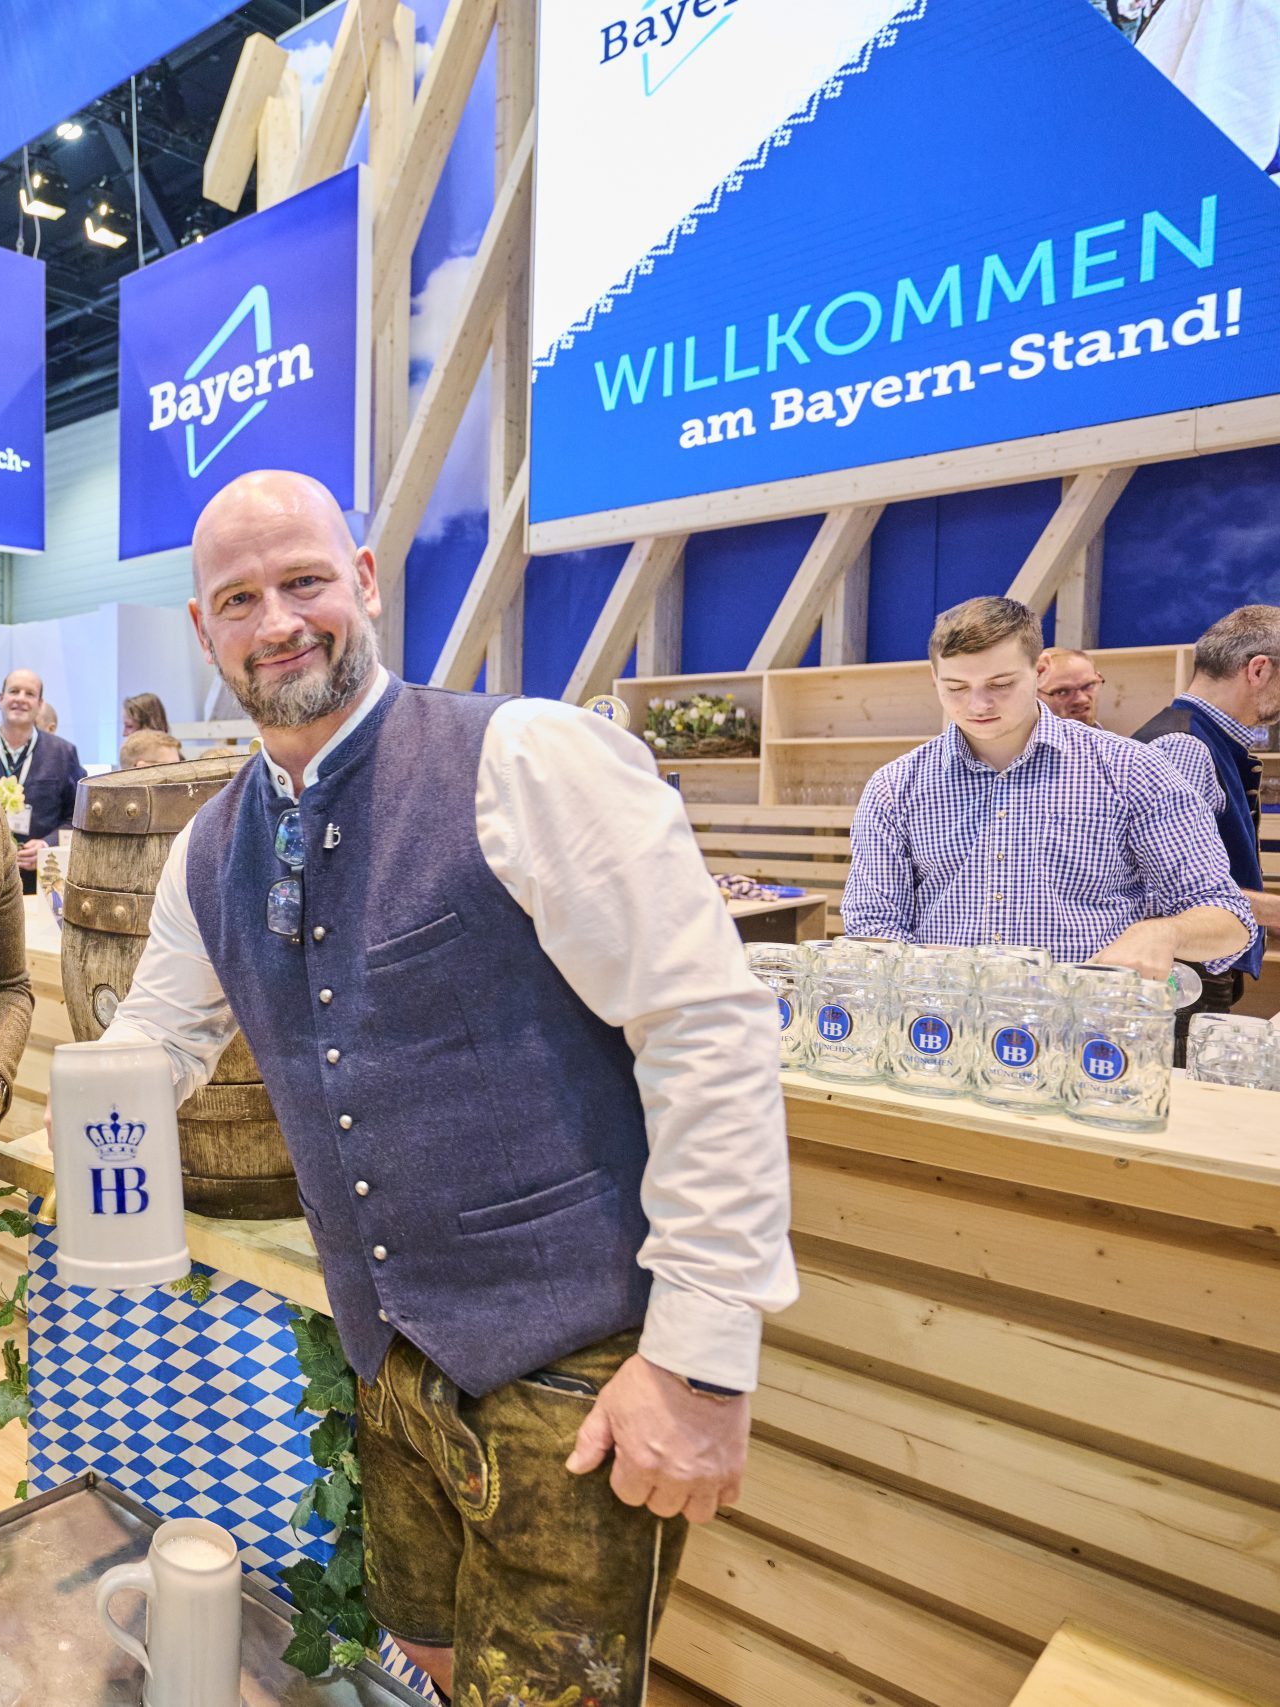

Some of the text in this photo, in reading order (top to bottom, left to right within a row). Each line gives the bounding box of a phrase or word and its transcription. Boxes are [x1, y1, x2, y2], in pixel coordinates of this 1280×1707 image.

[599, 0, 739, 65] Baye
[594, 194, 1218, 412] WILLKOMMEN
[148, 343, 314, 432] Bayern
[679, 288, 1243, 448] am Bayern-Stand!
[823, 1021, 843, 1037] HB
[919, 1034, 942, 1050] HB
[1002, 1045, 1027, 1062] HB
[1089, 1058, 1114, 1077] HB
[89, 1167, 149, 1215] HB
